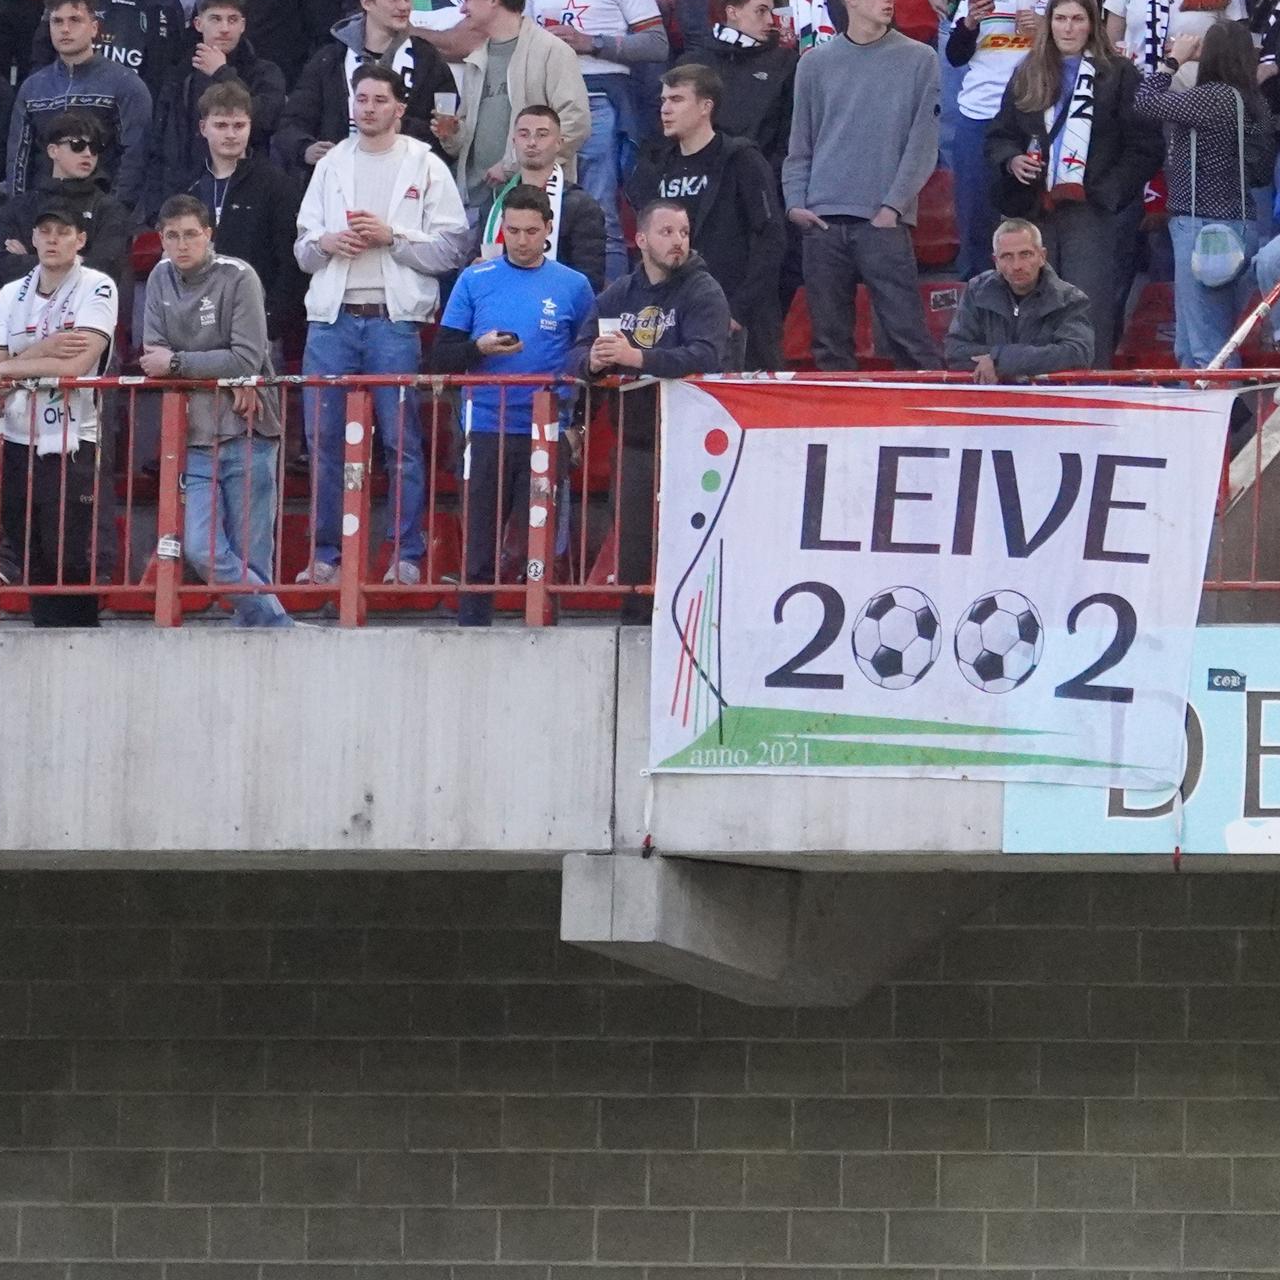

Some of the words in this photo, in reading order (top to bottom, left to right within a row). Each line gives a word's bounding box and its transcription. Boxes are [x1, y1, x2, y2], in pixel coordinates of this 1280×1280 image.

[799, 443, 1168, 565] LEIVE
[690, 746, 749, 767] anno
[757, 741, 812, 766] 2021
